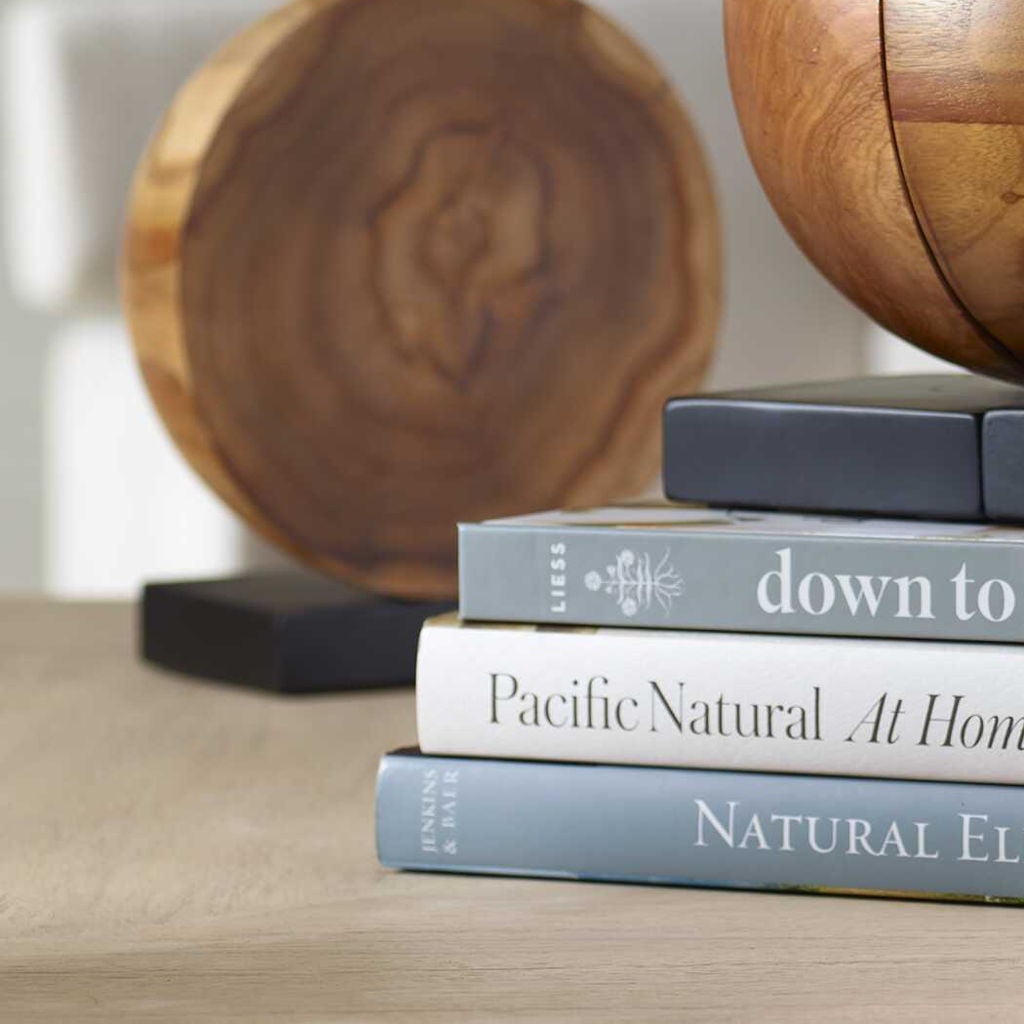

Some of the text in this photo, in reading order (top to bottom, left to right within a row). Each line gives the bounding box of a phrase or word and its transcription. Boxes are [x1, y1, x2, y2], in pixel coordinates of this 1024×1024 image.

[551, 542, 567, 613] LIESS
[756, 547, 936, 619] down
[951, 562, 1015, 623] to
[488, 673, 640, 732] Pacific
[649, 681, 824, 742] Natural
[843, 692, 906, 745] At
[421, 768, 438, 854] JENKINS
[442, 771, 459, 828] BAER
[693, 798, 940, 859] NATURAL
